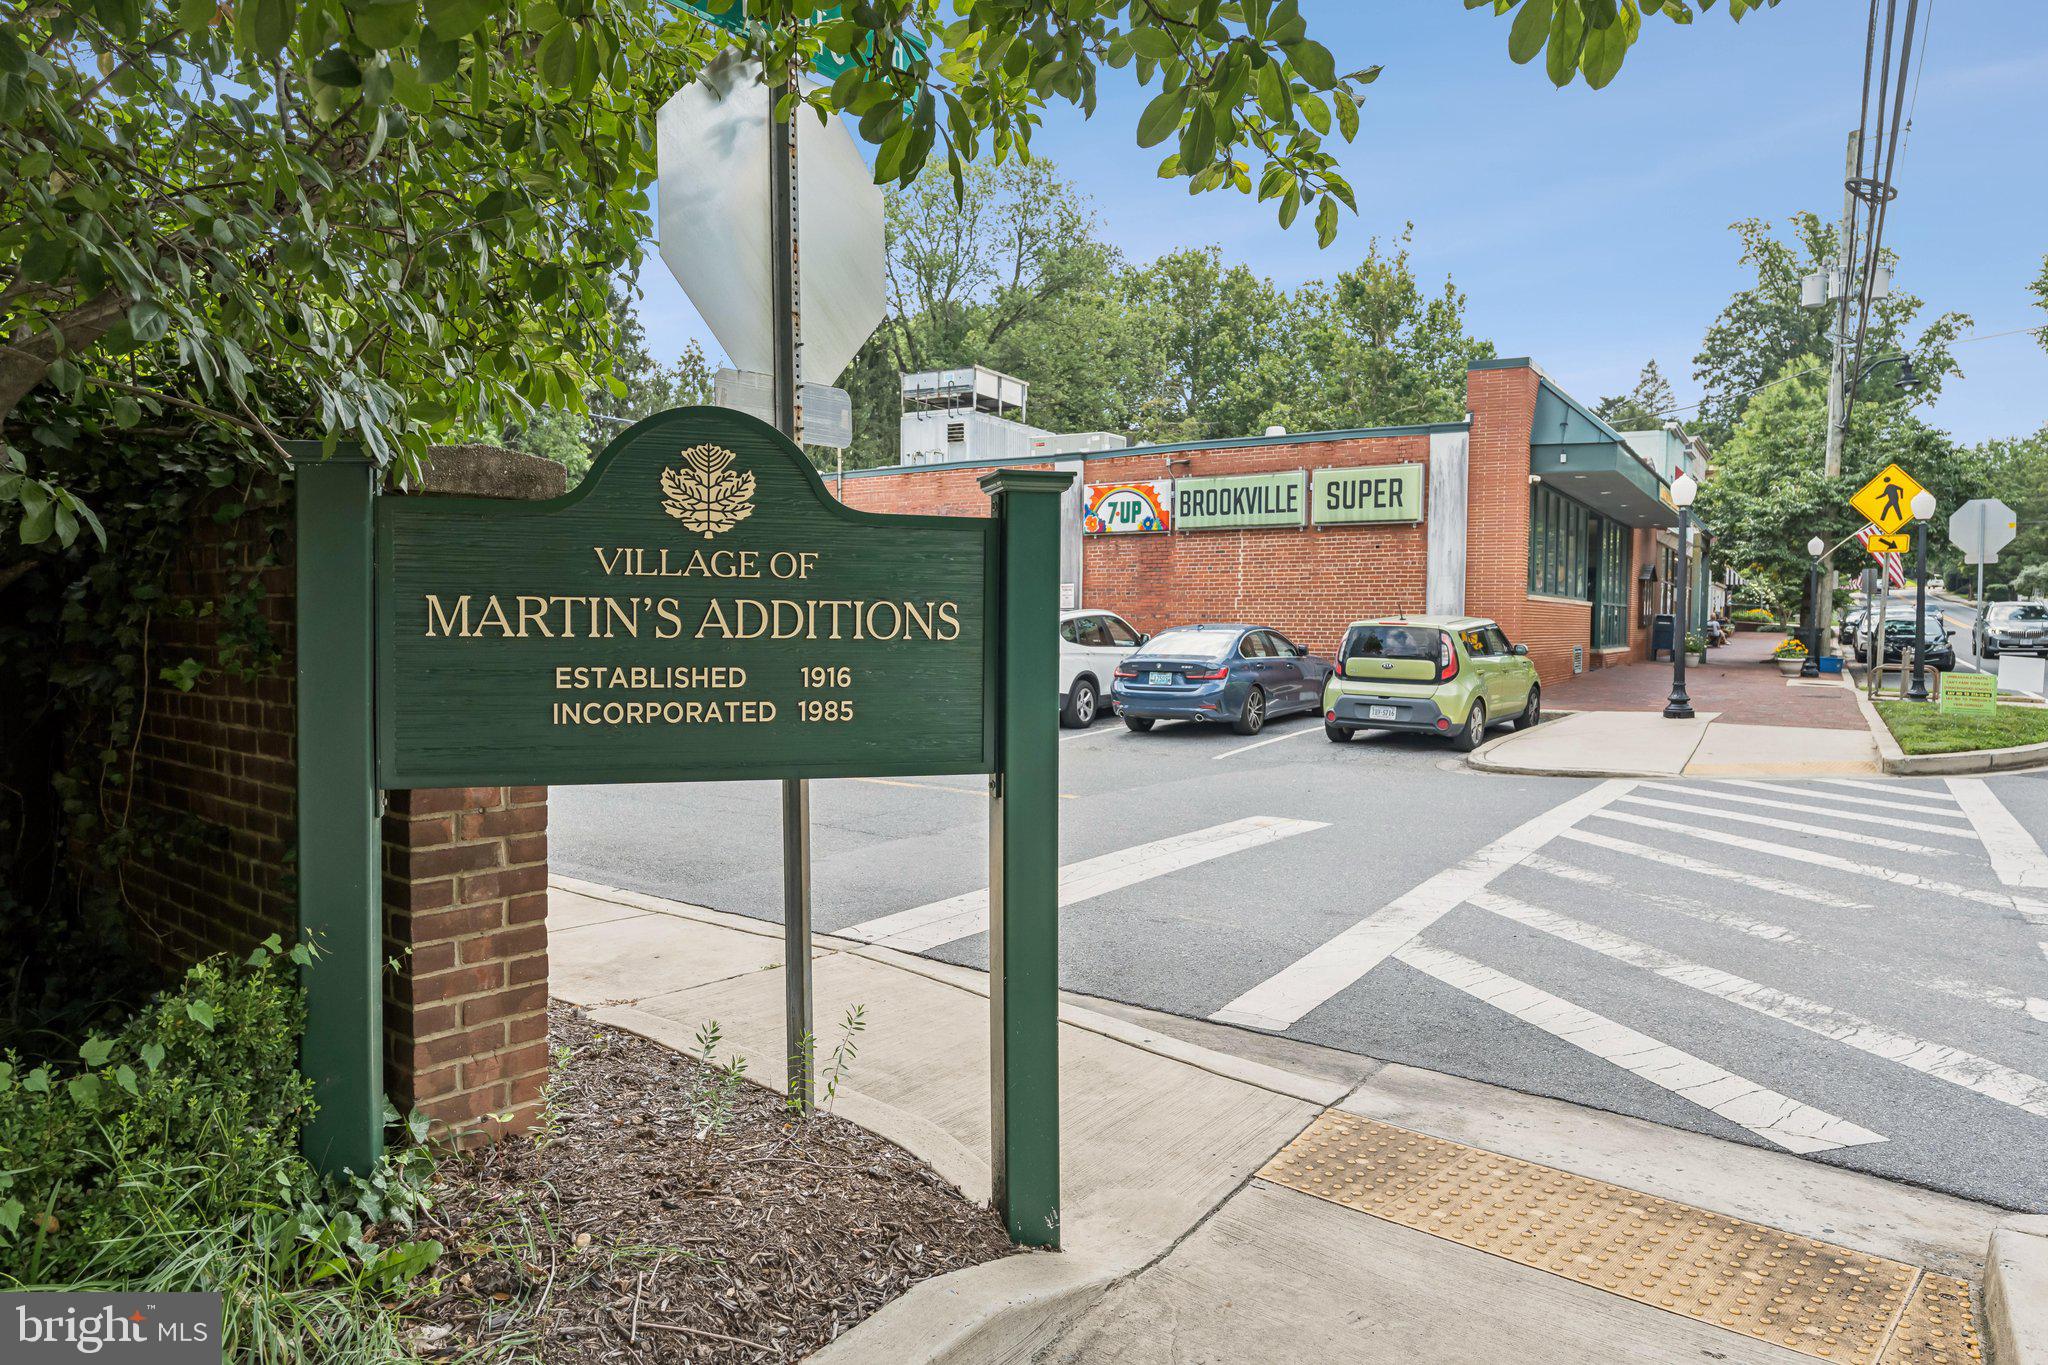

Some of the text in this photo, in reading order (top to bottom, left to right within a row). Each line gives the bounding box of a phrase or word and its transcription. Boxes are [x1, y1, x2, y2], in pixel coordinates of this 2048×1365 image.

[1180, 484, 1298, 518] BROOKVILLE
[1327, 477, 1403, 510] SUPER
[594, 546, 818, 579] VILLAGE OF
[425, 594, 960, 641] MARTIN'S ADDITIONS
[556, 666, 852, 689] ESTABLISHED 1916
[553, 700, 854, 725] INCORPORATED 1985
